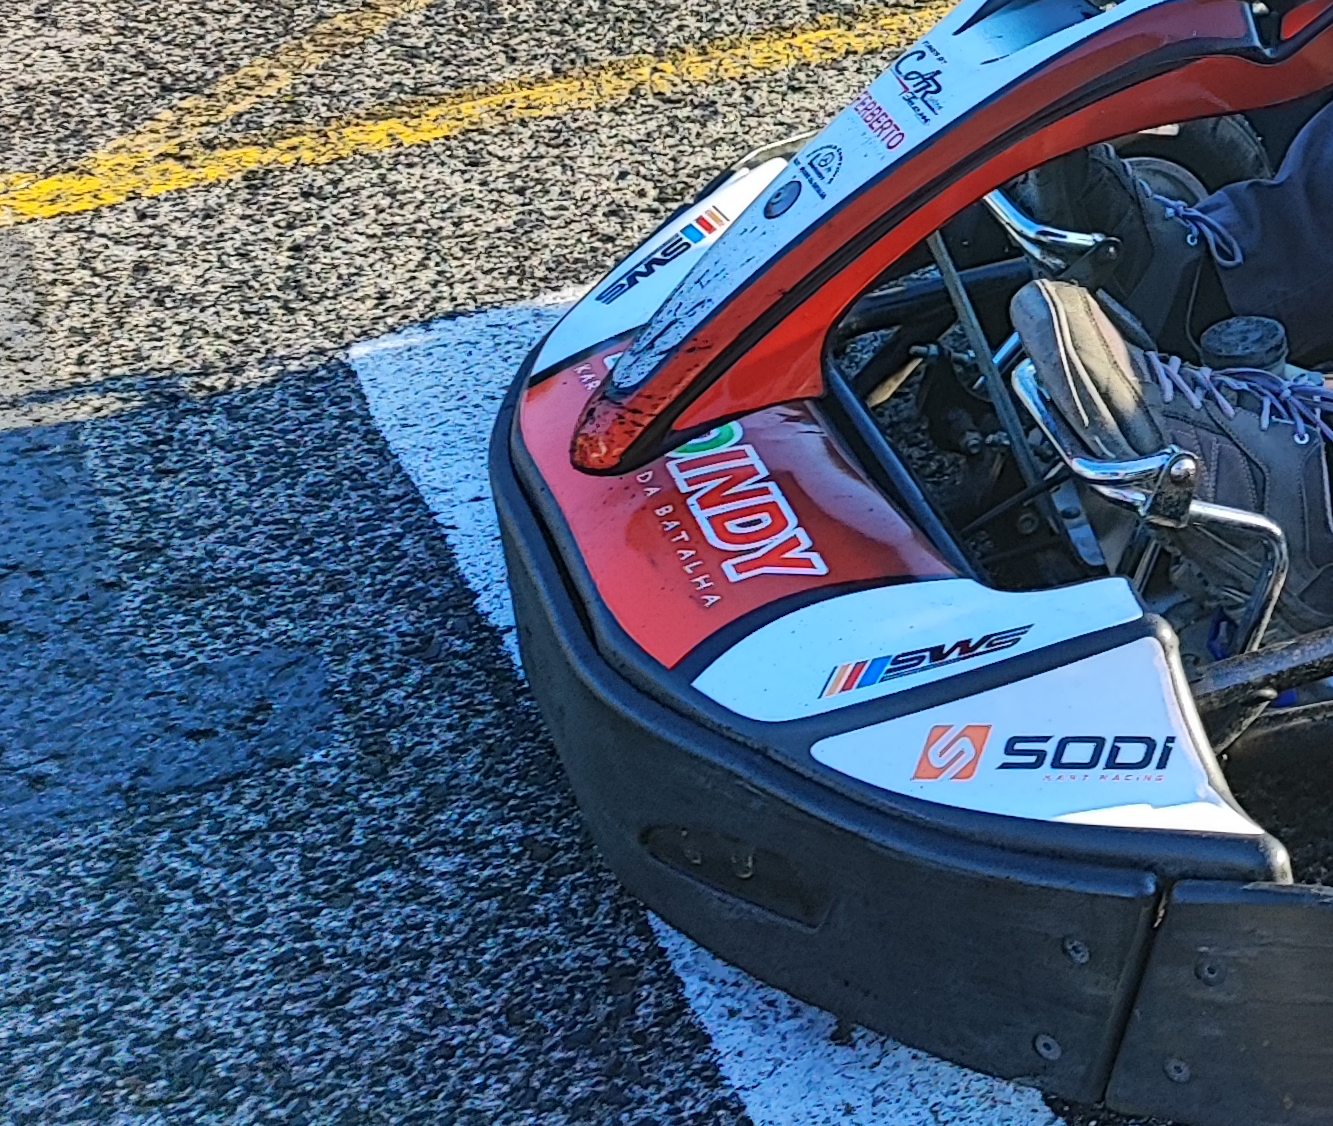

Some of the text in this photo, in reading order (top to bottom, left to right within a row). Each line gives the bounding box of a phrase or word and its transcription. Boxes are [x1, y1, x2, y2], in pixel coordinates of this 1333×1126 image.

[636, 470, 722, 608] DA BATALHA
[665, 420, 830, 583] INDY
